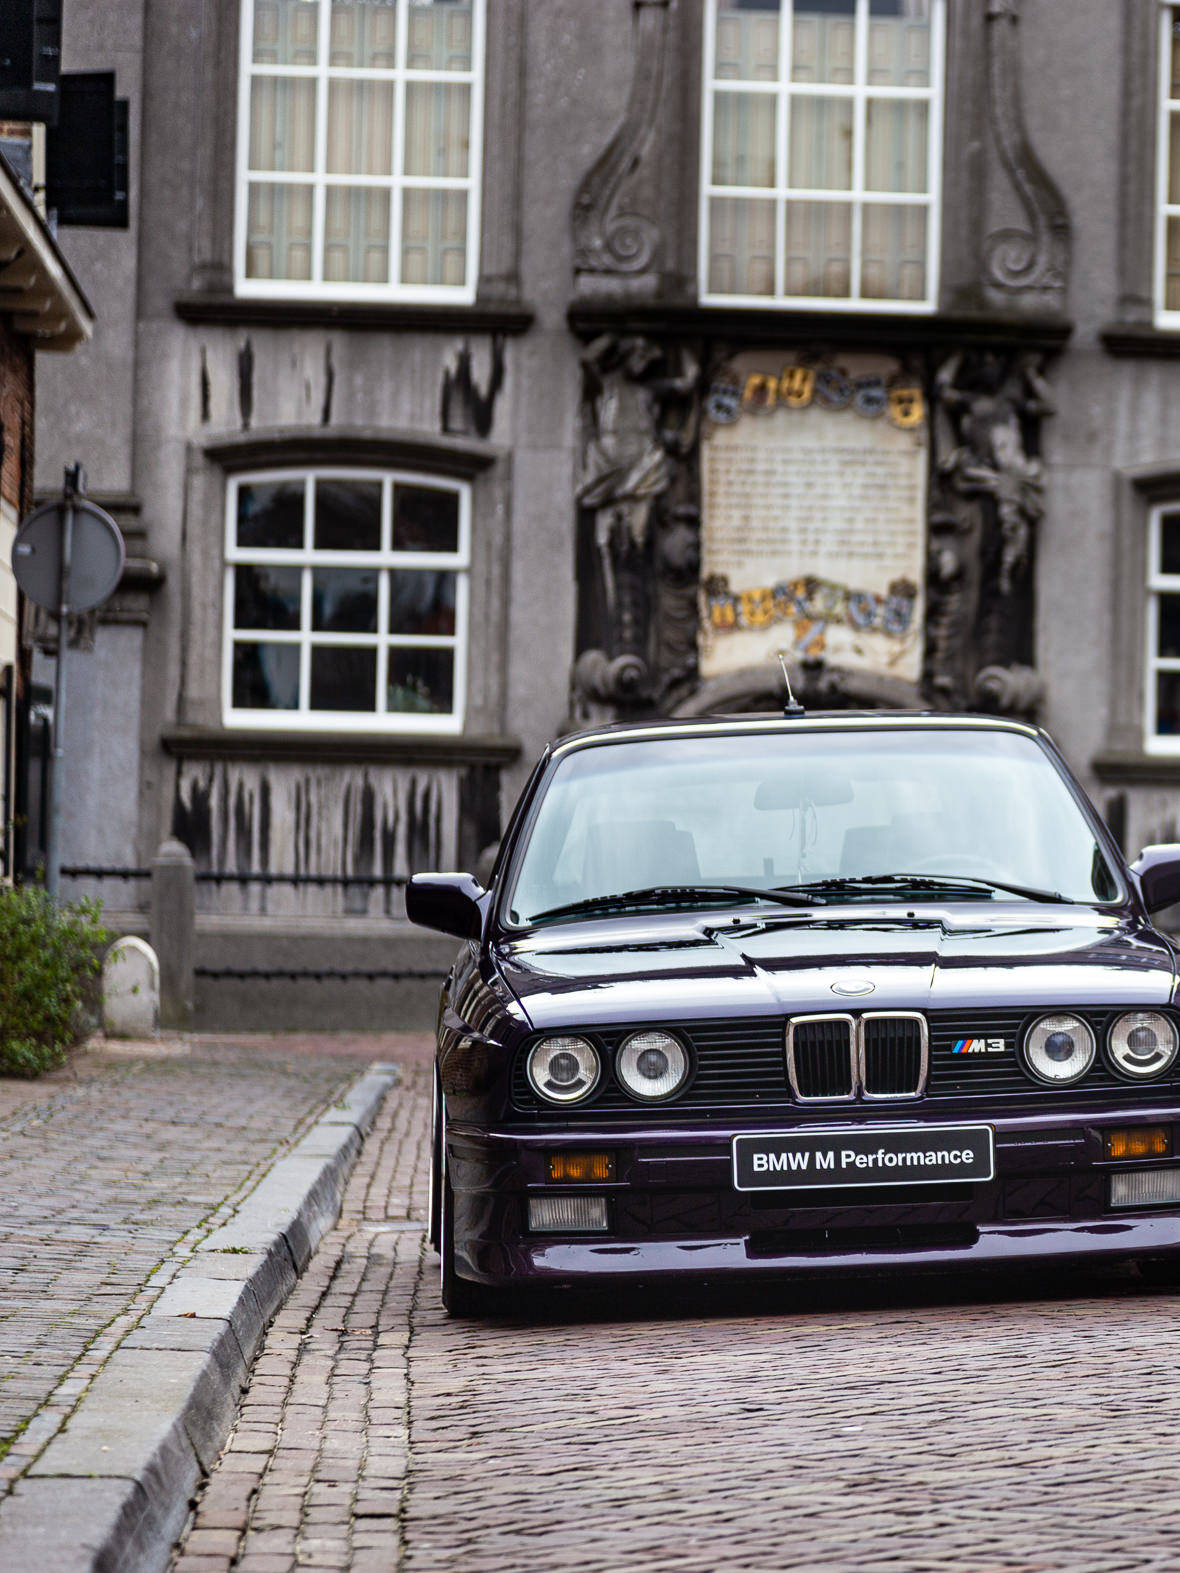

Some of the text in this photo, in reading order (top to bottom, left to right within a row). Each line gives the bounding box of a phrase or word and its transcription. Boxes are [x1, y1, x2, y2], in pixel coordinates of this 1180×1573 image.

[969, 1038, 1005, 1054] M3
[752, 1148, 975, 1172] BMW M Performance
